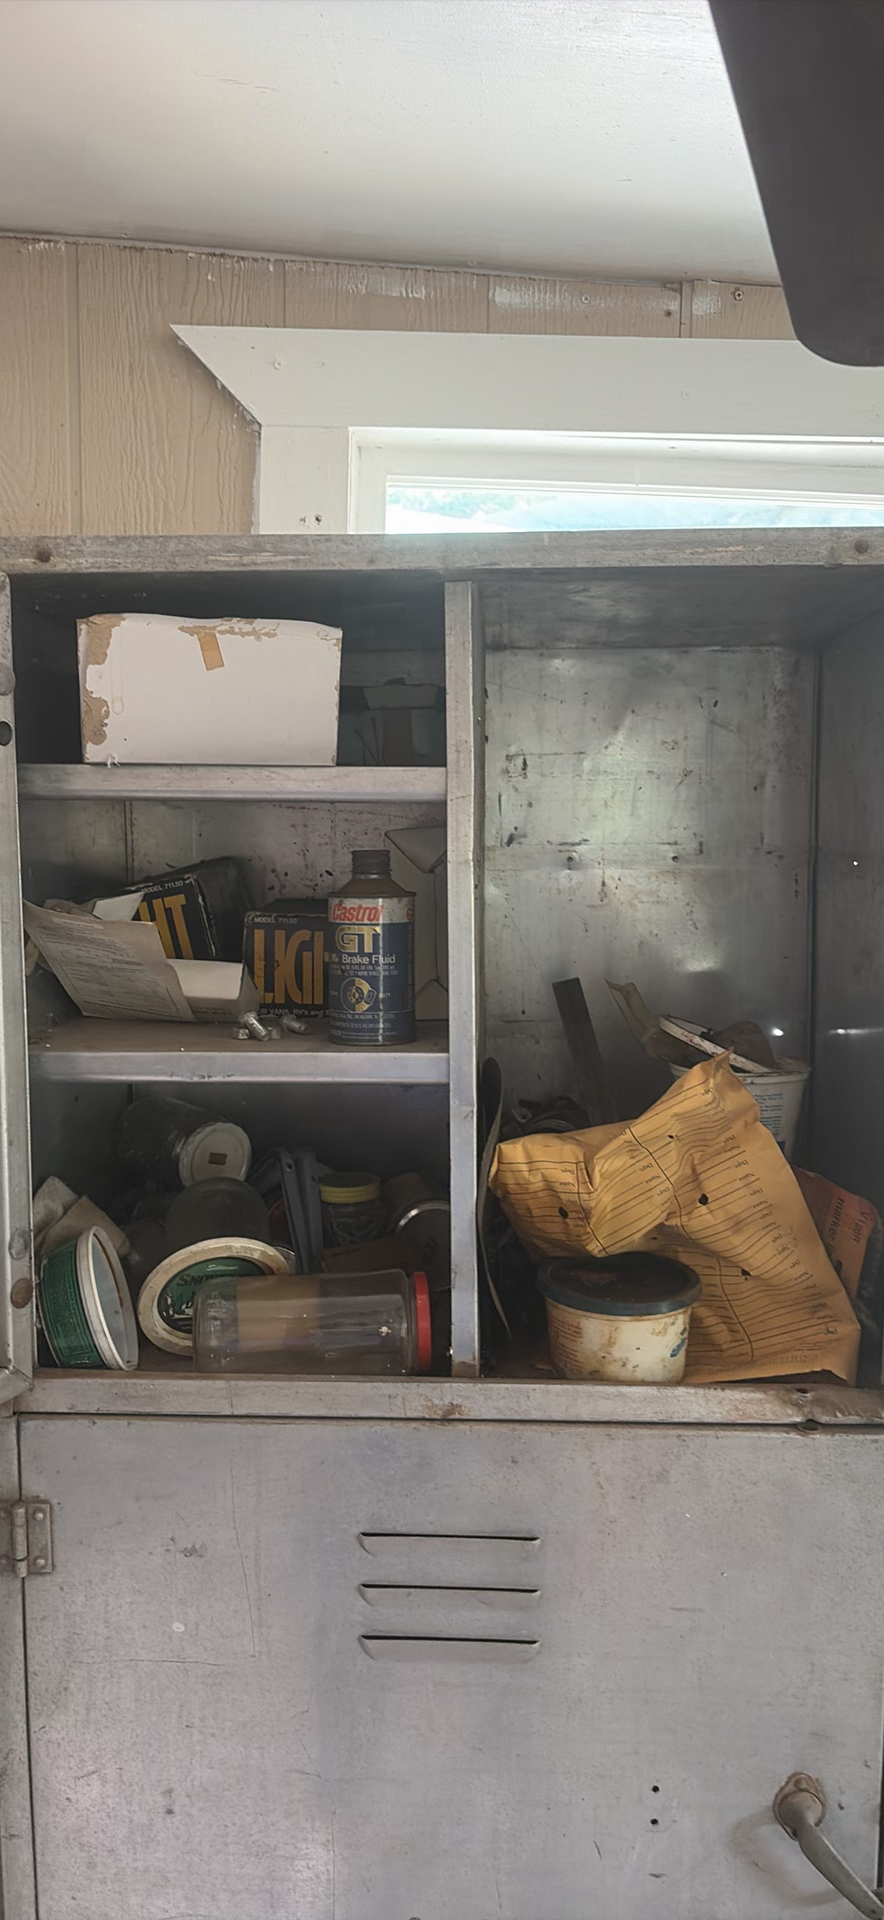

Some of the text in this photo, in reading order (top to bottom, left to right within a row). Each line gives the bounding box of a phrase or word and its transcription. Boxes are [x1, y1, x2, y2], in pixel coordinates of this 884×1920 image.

[332, 903, 384, 922] Castrol
[336, 925, 382, 953] GT
[342, 954, 370, 964] Brake
[372, 954, 396, 964] Fluid
